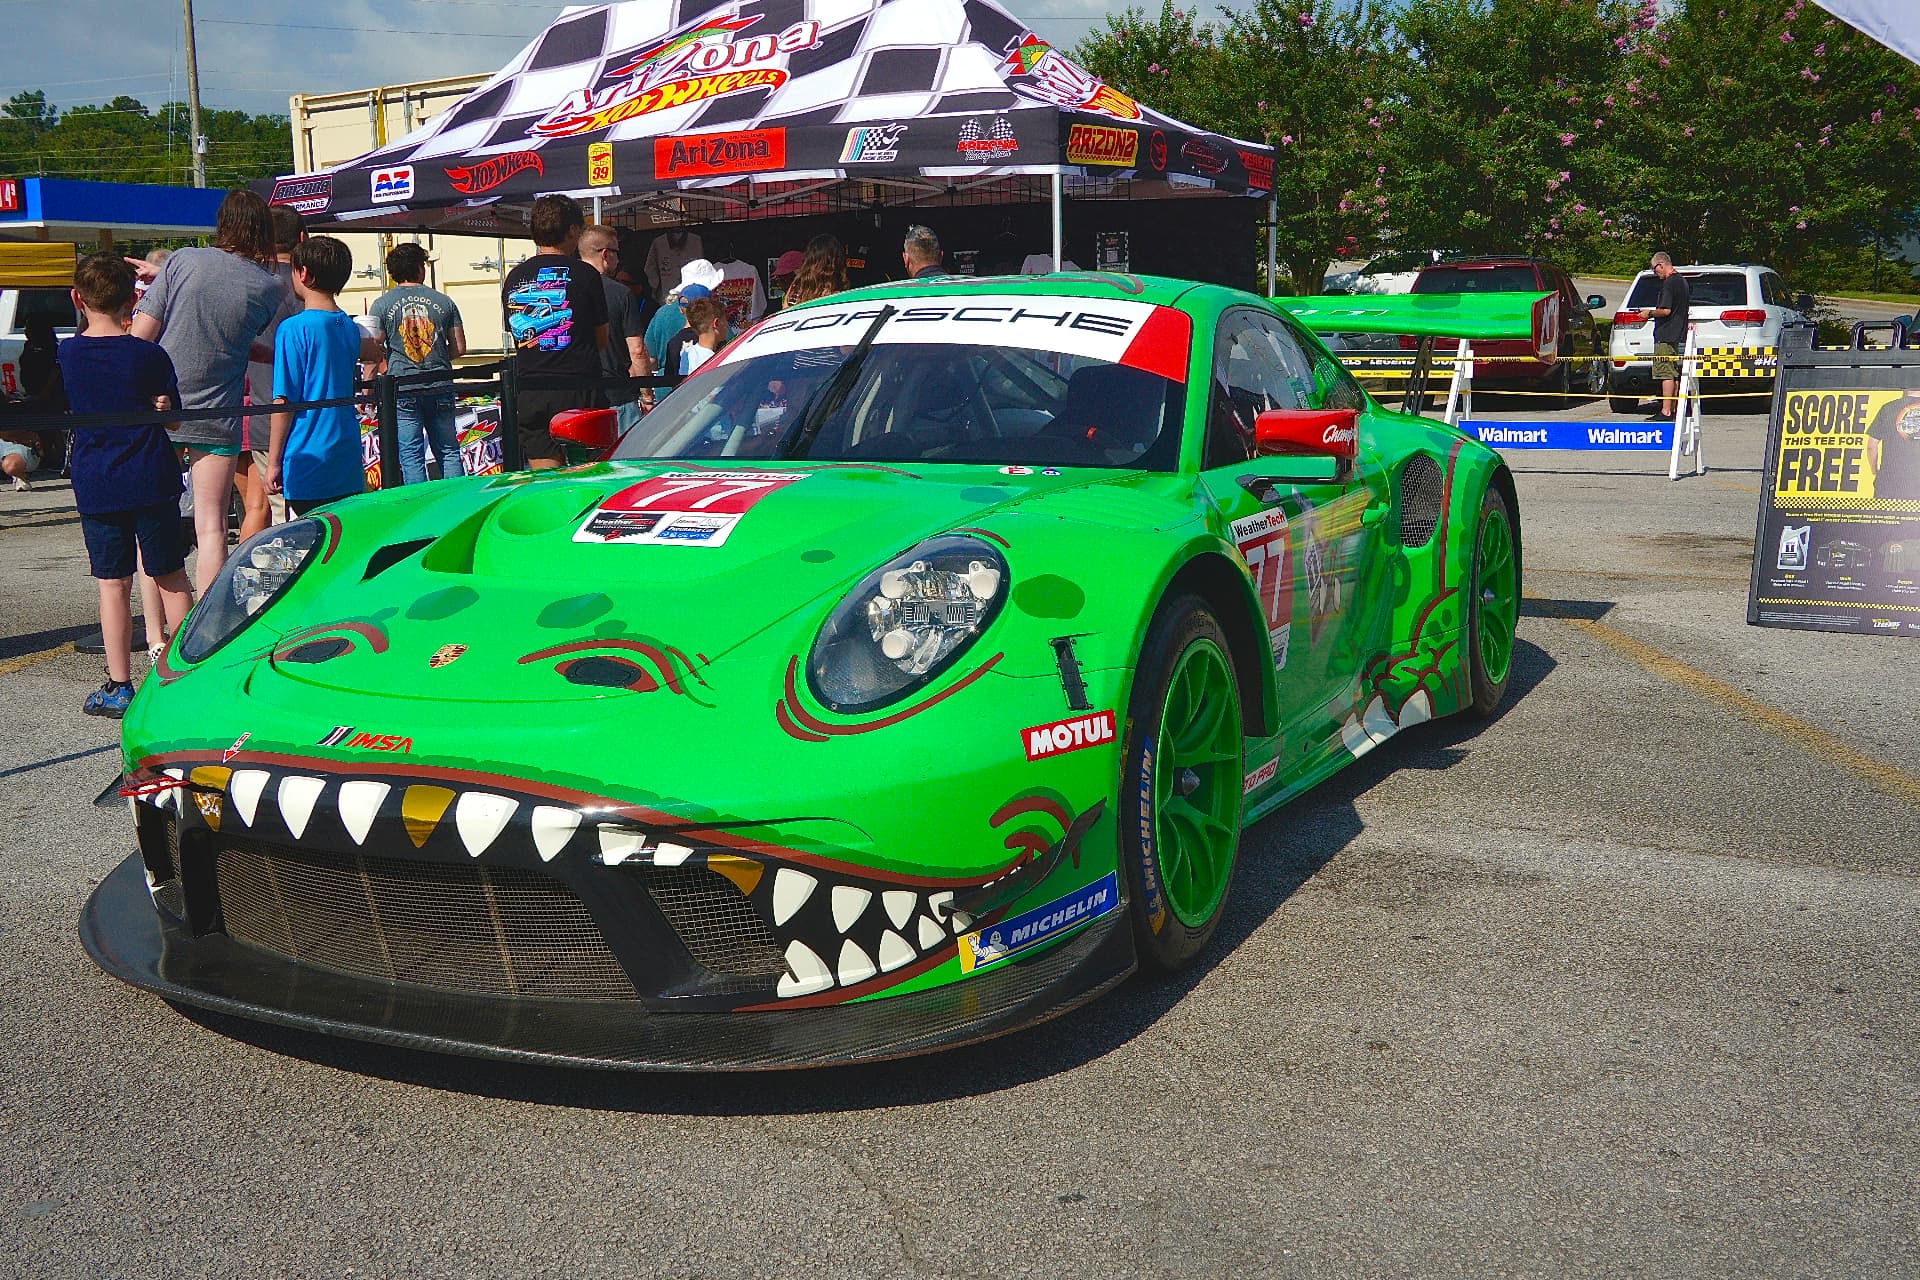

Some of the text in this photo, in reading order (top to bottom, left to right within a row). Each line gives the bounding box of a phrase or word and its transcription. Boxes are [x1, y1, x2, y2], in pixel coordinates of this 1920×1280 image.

[668, 138, 769, 172] AriZona
[957, 139, 1018, 152] ARIZONA
[592, 165, 609, 180] 99
[294, 200, 325, 211] RMANCE
[387, 300, 402, 320] JUST
[408, 295, 432, 305] GOOD
[748, 306, 1134, 344] PORSCHE
[1786, 394, 1869, 435] SCORE
[1477, 426, 1663, 444] Walmart Walmart
[1785, 436, 1864, 446] THIS TEE FOR
[668, 472, 806, 480] WeatherTech
[1778, 448, 1864, 493] FREE
[631, 480, 777, 509] 77
[1233, 511, 1285, 539] WeatherTech
[1246, 537, 1285, 622] 77
[346, 732, 413, 753] IMSA
[1030, 715, 1113, 756] MOTUL
[1139, 748, 1156, 891] MICHELIN
[1010, 889, 1108, 945] MICHELIN
